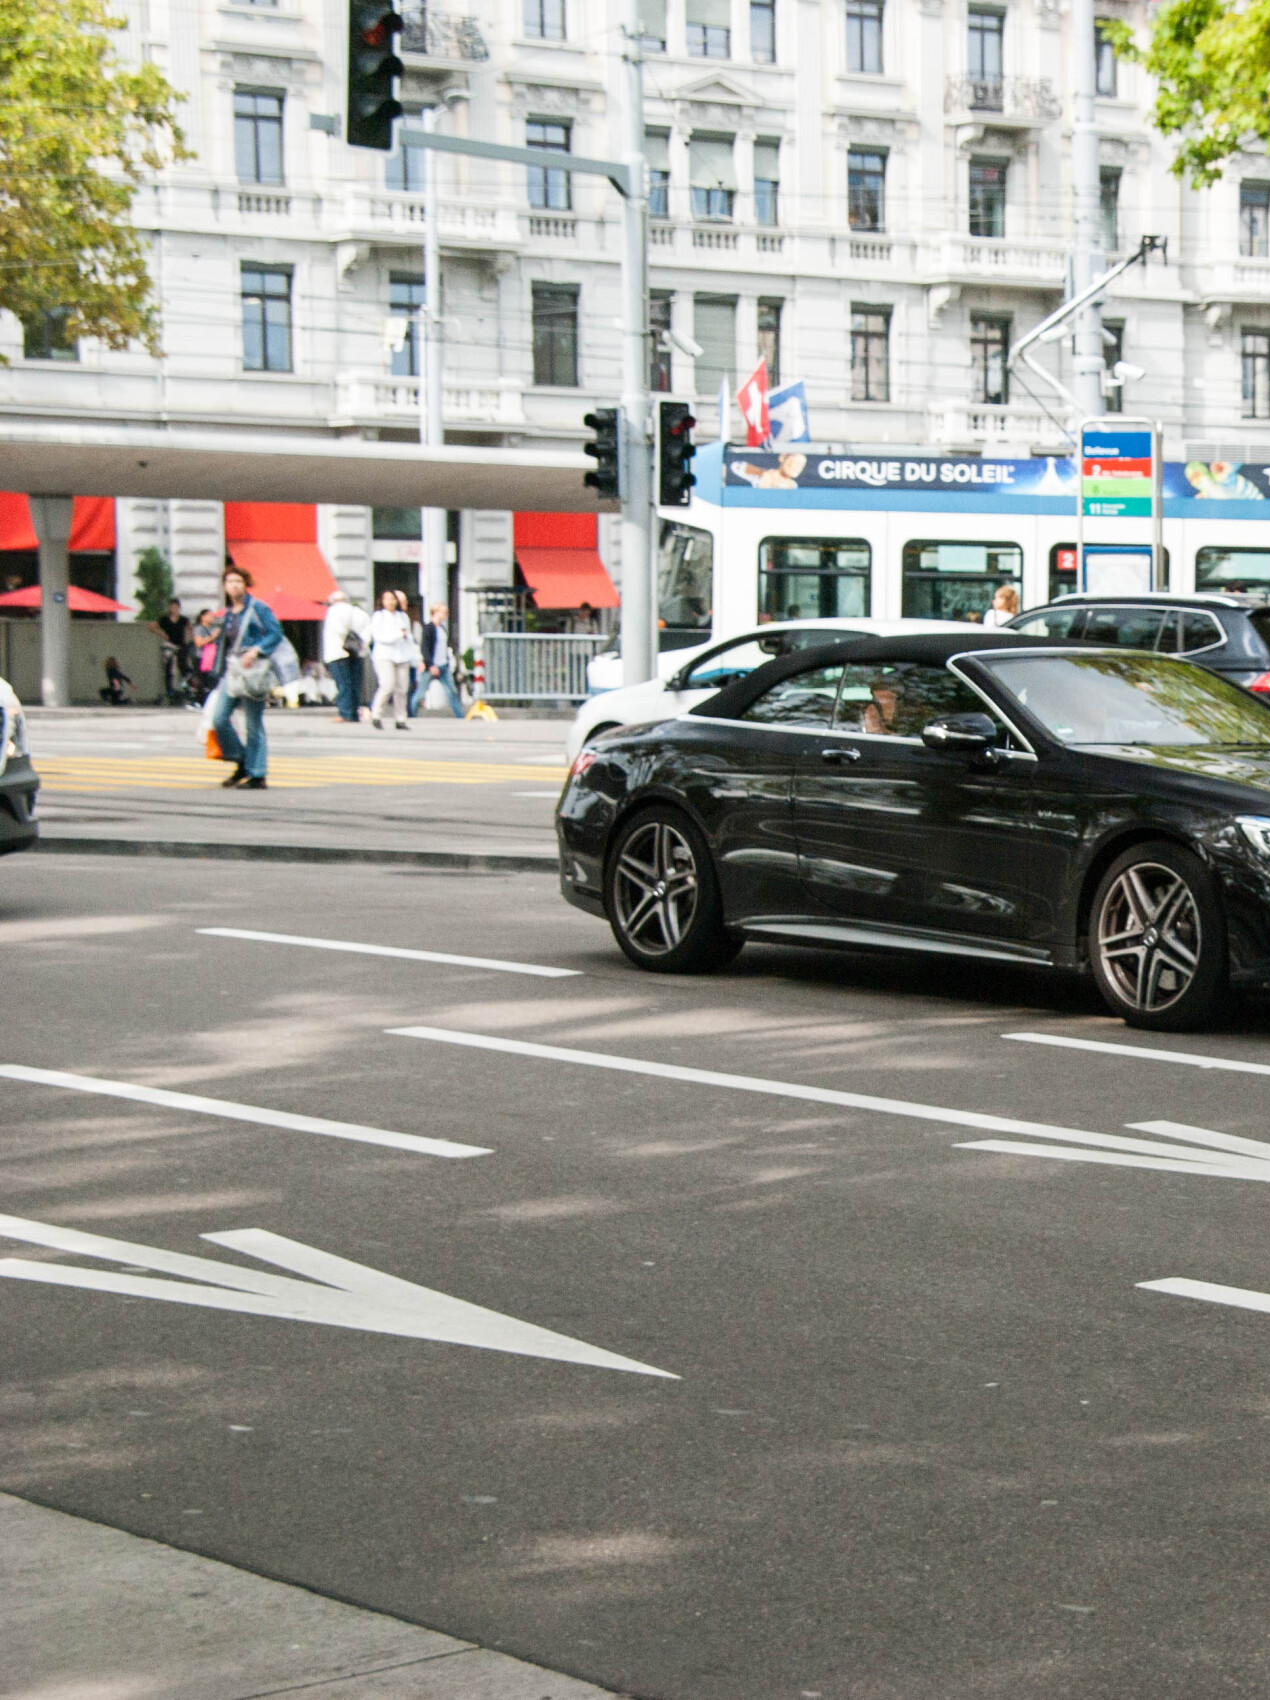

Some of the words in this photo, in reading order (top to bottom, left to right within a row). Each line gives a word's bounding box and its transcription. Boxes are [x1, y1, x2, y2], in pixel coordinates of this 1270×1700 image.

[818, 460, 901, 486] CIRQUE
[904, 462, 937, 482] DU
[1062, 552, 1074, 569] 2
